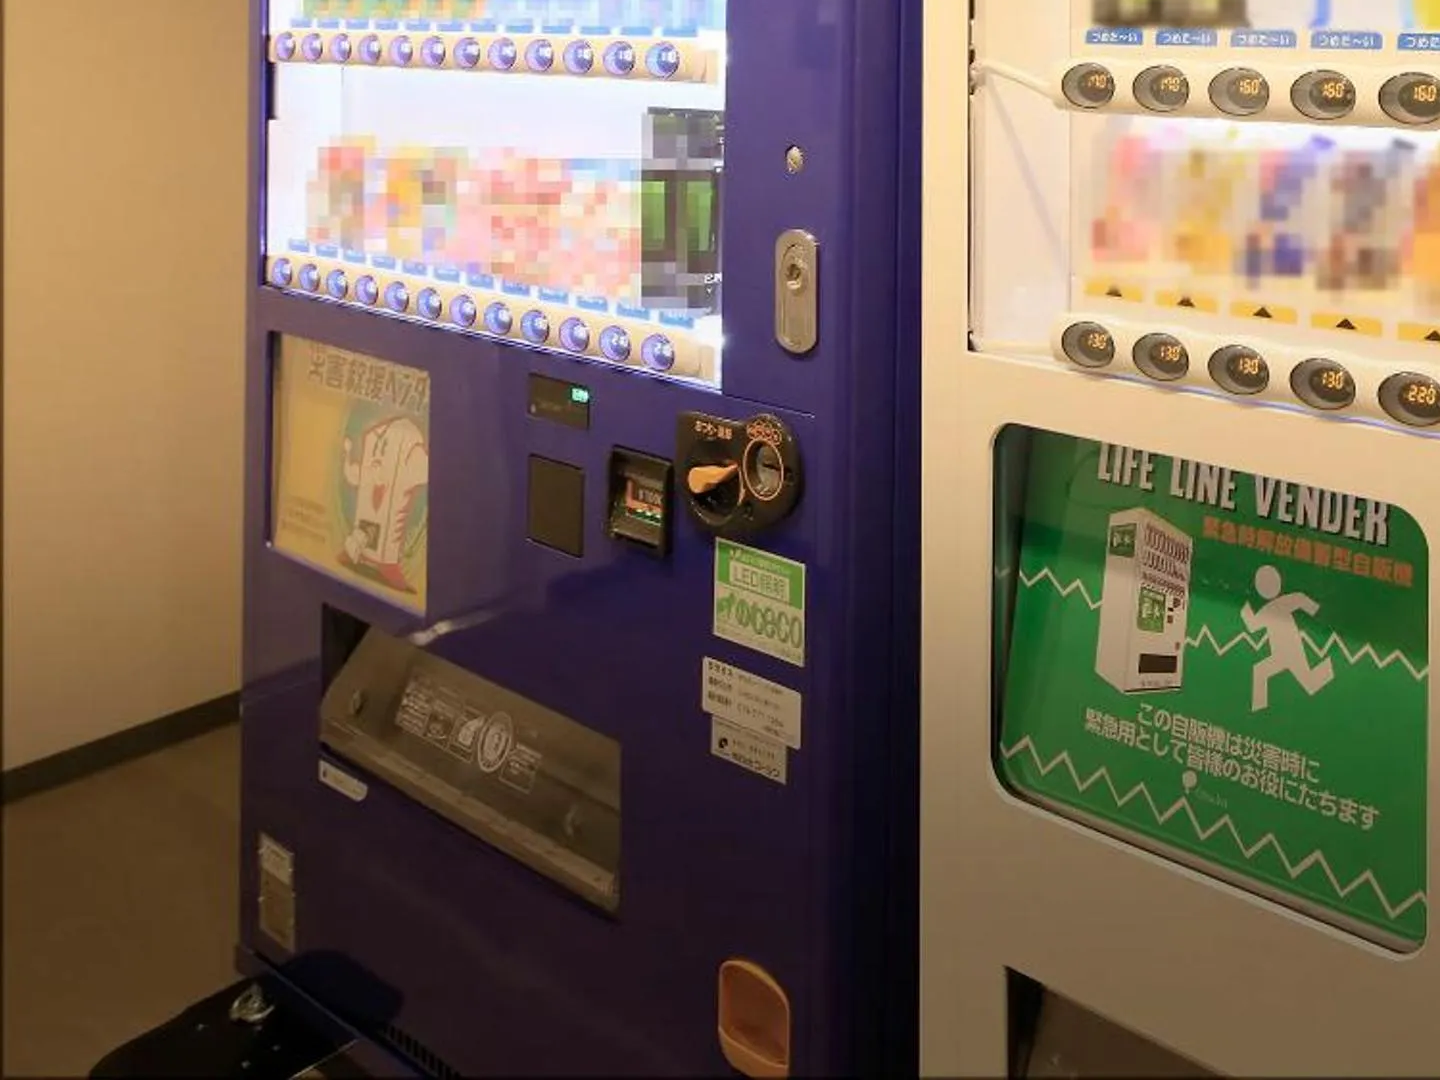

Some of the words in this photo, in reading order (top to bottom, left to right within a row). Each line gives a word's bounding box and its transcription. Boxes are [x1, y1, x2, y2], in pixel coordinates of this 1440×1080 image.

[1240, 356, 1259, 375] 130
[1408, 384, 1436, 405] 220
[1097, 442, 1156, 491] LIFE
[1169, 455, 1236, 510] LINE
[1253, 473, 1390, 547] VENDER
[1084, 706, 1379, 831] 緊急用として皆様のお役にたちます
[1136, 702, 1321, 785] この自販機は災害時に
